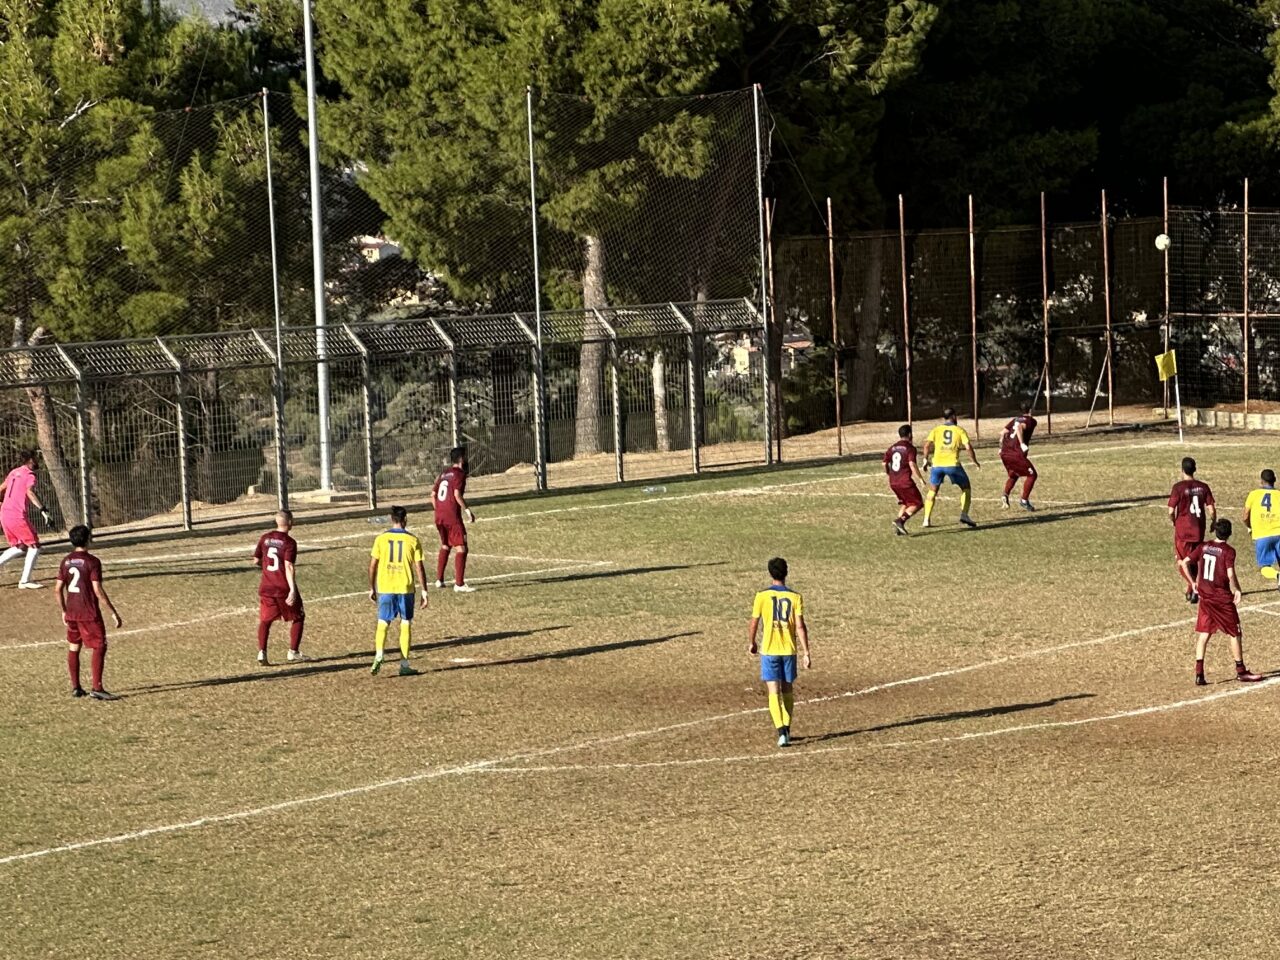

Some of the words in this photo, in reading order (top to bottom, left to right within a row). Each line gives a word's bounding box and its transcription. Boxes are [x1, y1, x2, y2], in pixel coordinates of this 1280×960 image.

[943, 429, 953, 445] 9
[892, 452, 902, 472] 8
[9, 478, 15, 498] 1
[437, 480, 448, 502] 6
[1190, 495, 1201, 518] 4
[1261, 493, 1272, 512] 4
[267, 547, 279, 572] 5
[388, 540, 403, 563] 11
[1203, 553, 1216, 581] 11
[68, 566, 80, 593] 2
[771, 596, 791, 622] 10
